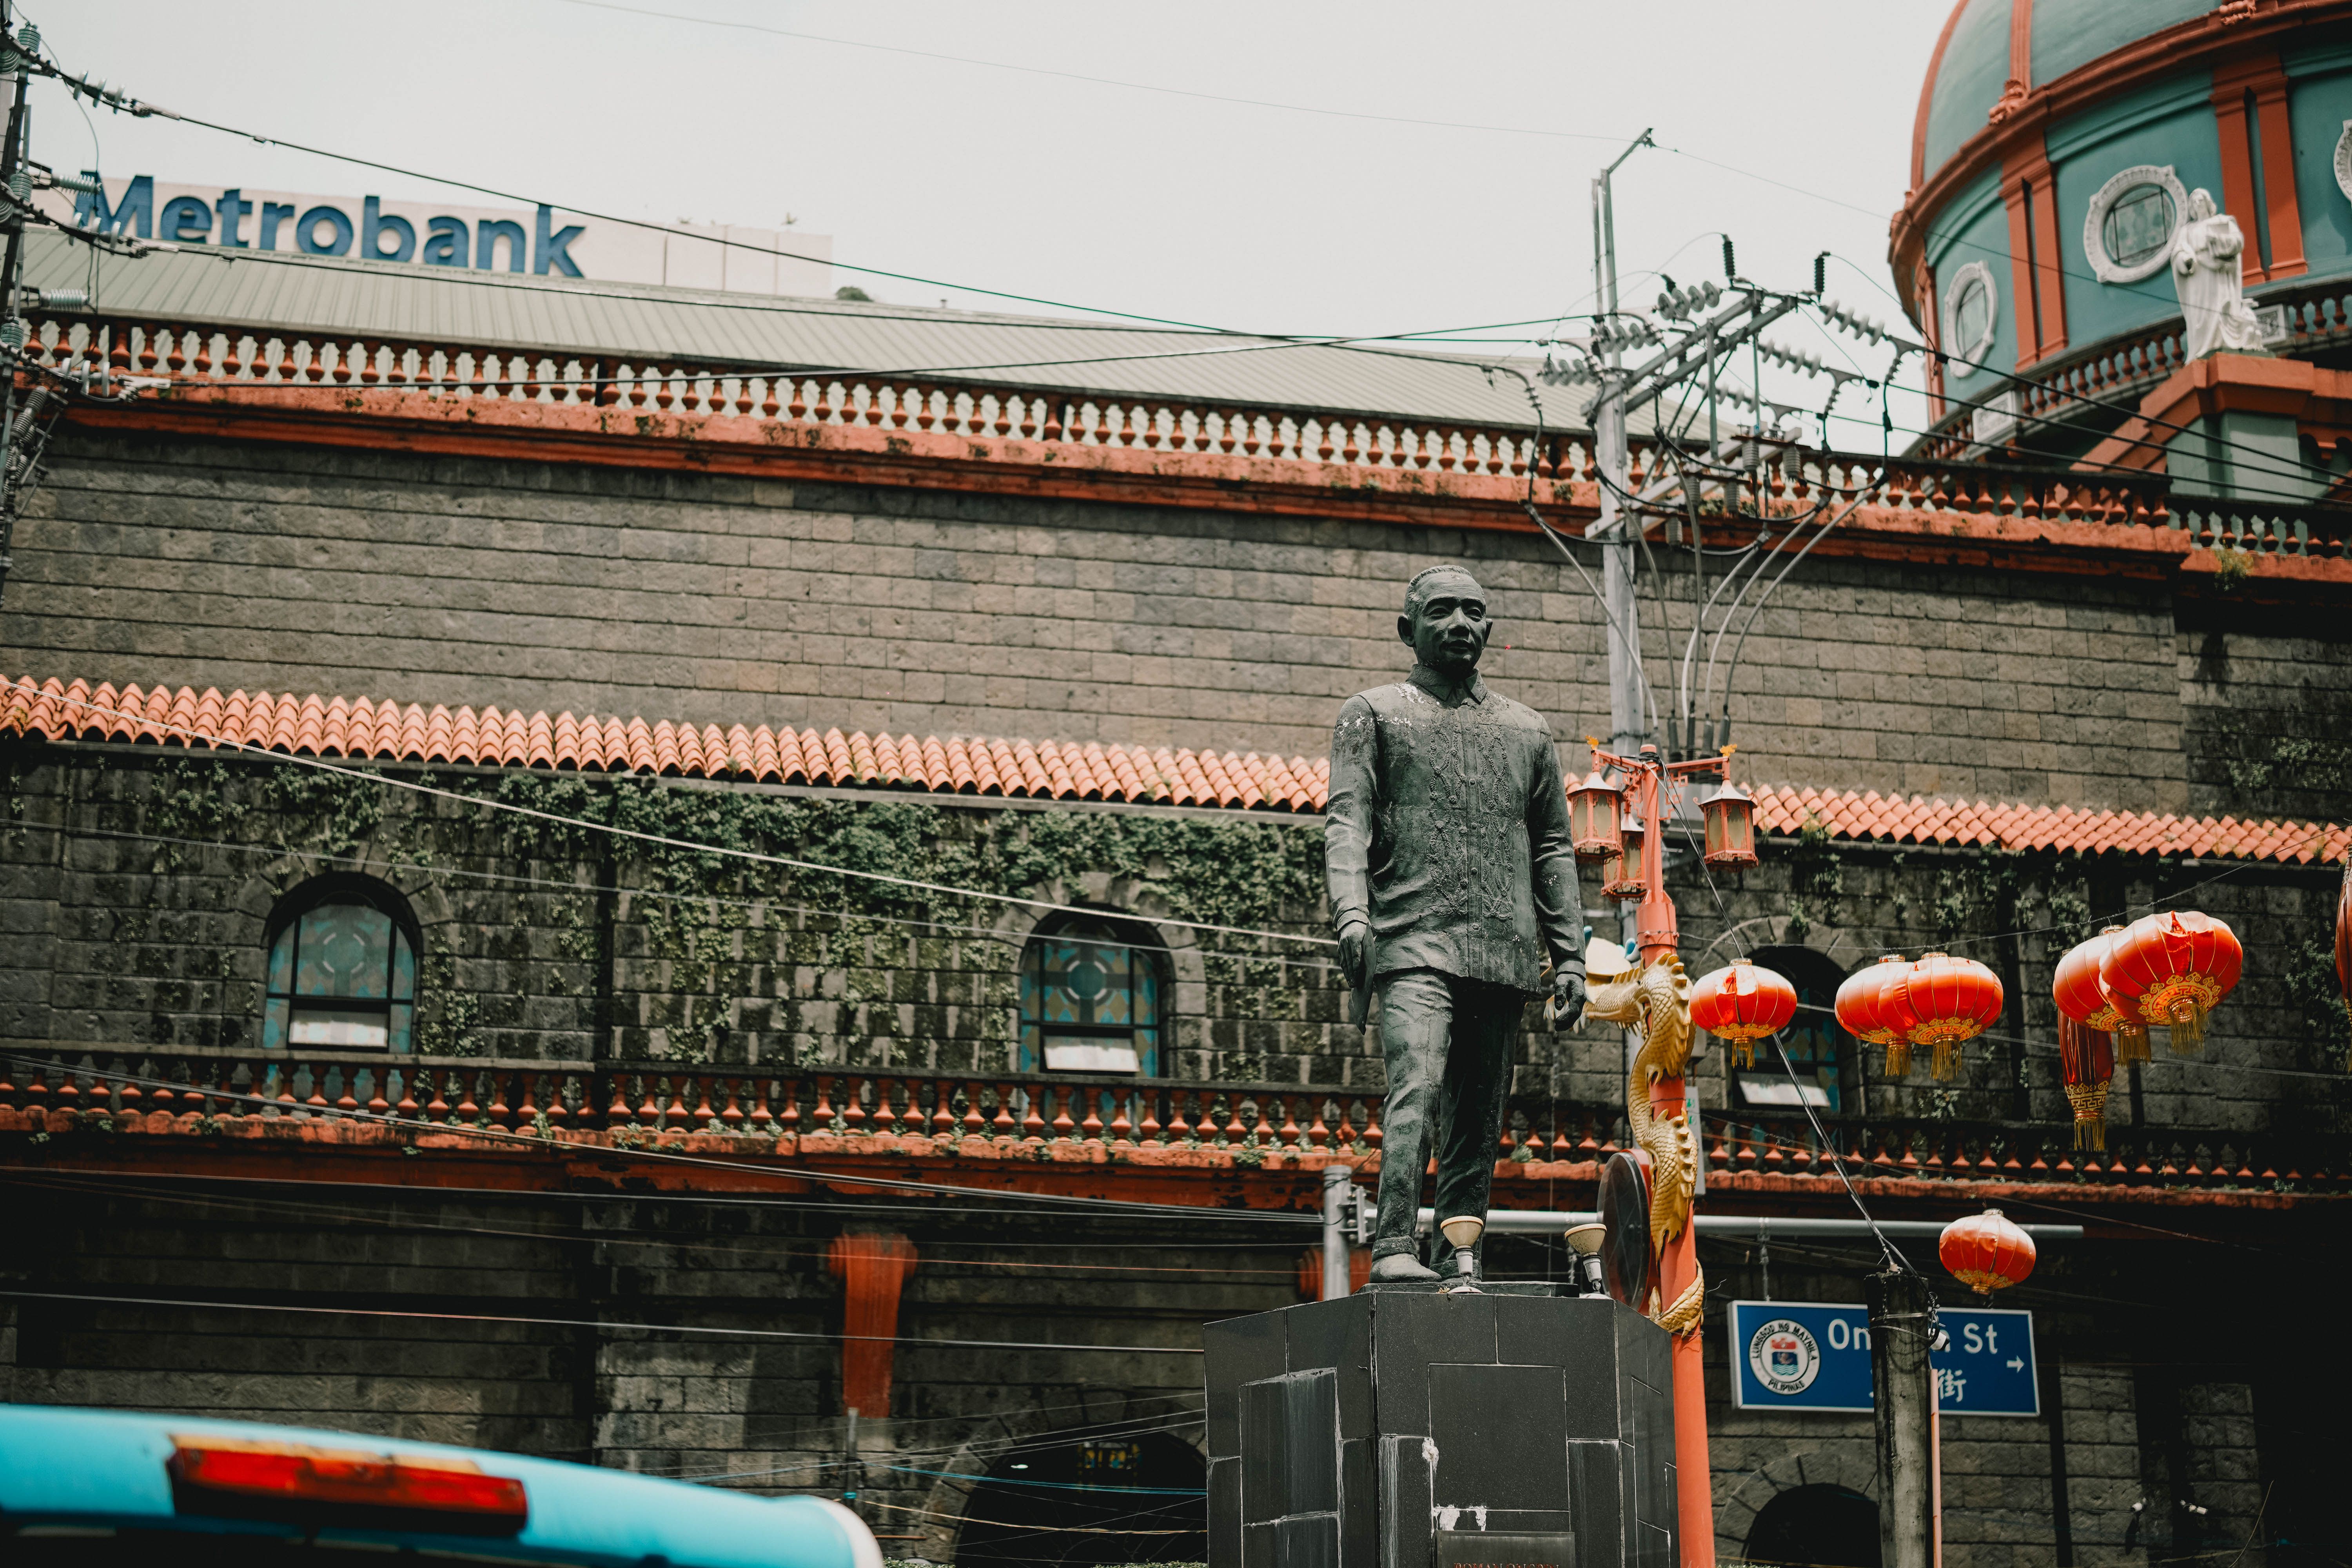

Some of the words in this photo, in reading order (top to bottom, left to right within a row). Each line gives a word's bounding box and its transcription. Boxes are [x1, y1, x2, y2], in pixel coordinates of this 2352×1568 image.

[75, 170, 586, 279] Metrobank
[1792, 1326, 1818, 1361] MAYNILA
[1964, 1323, 1998, 1354] St
[1768, 1378, 1805, 1392] PILIPINAS
